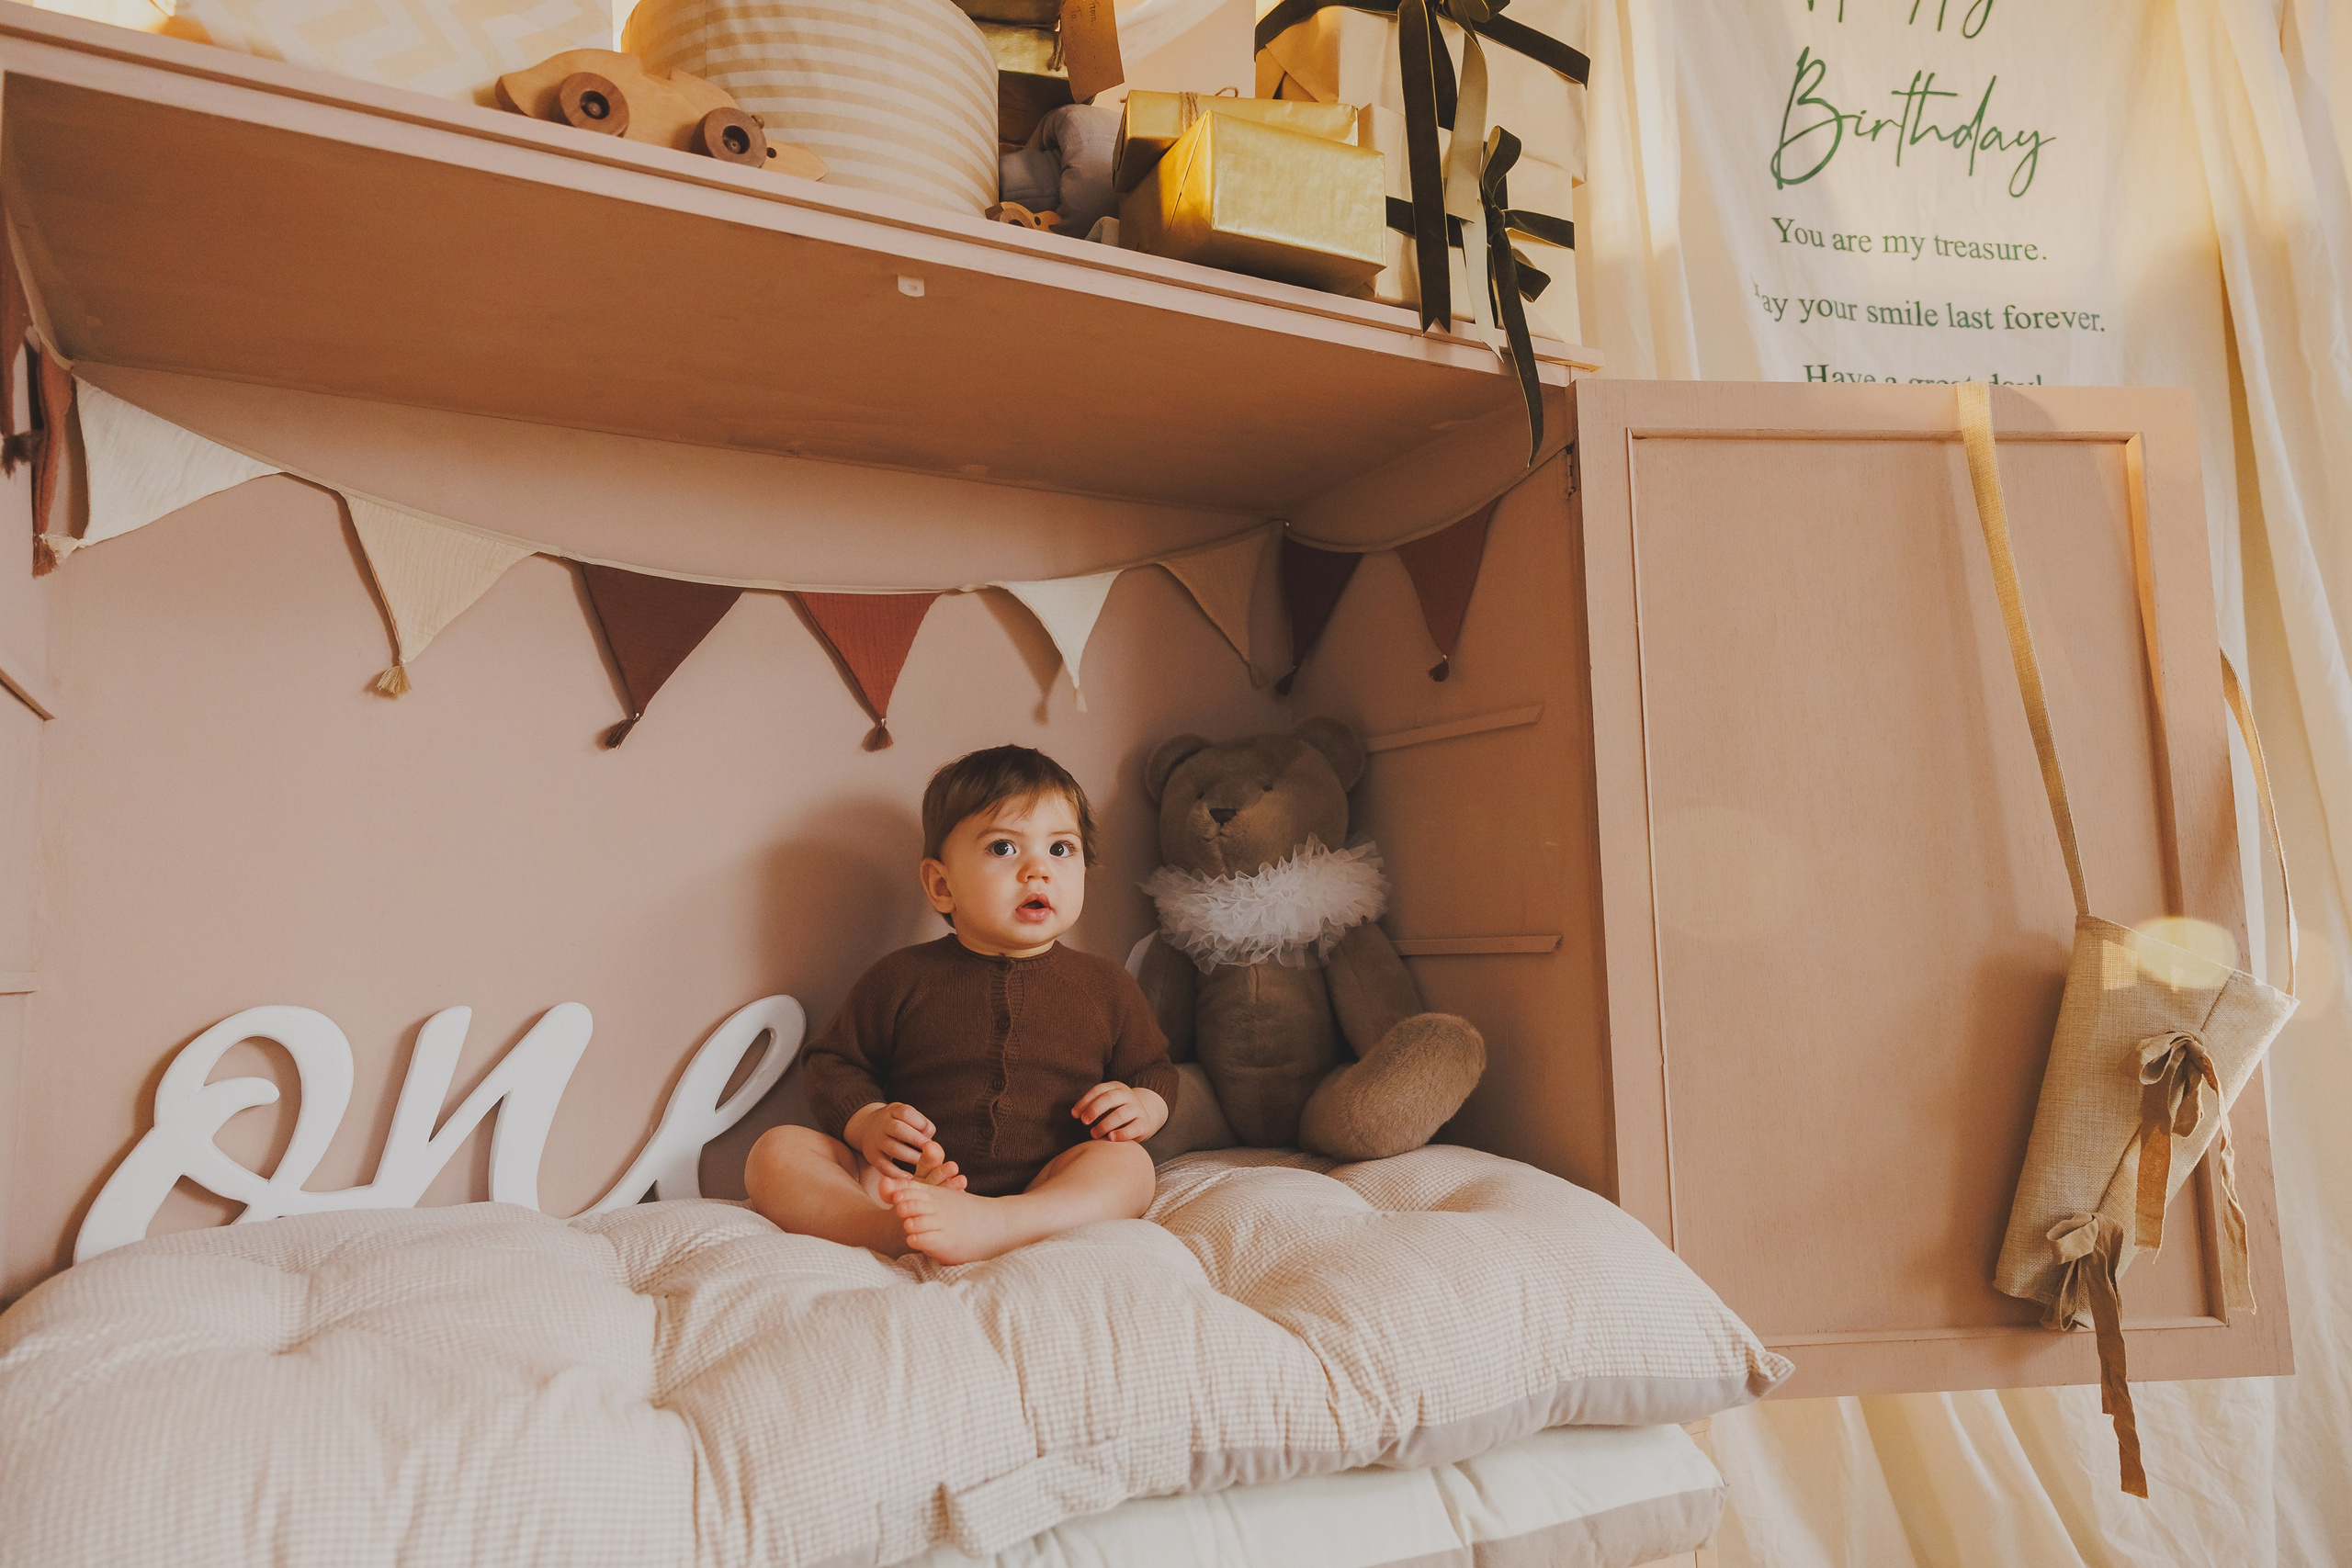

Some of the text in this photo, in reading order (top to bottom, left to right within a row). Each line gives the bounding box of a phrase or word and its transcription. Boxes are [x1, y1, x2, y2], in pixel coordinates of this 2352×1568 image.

[1770, 46, 2056, 197] Birthday
[1771, 217, 2047, 261] You are my treasure.
[1799, 299, 1858, 323] your
[1867, 300, 1939, 327] smile
[1946, 302, 1994, 330] last
[2004, 305, 2105, 332] forever.
[74, 995, 807, 1266] one
